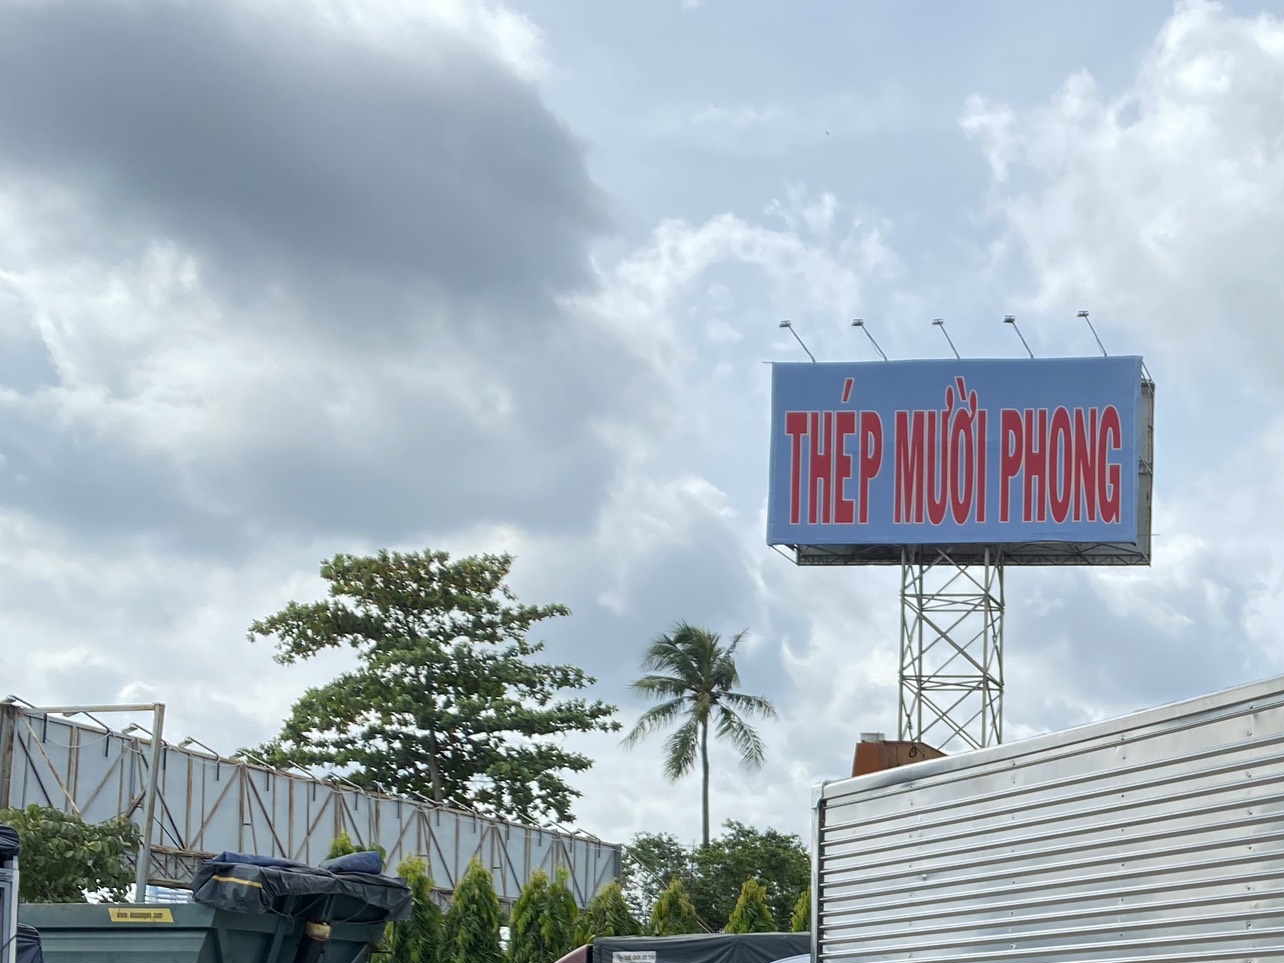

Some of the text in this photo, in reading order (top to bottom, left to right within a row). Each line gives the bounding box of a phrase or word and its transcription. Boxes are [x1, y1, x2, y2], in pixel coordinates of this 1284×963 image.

[785, 376, 1122, 526] THÉP MƯỜI PHONG
